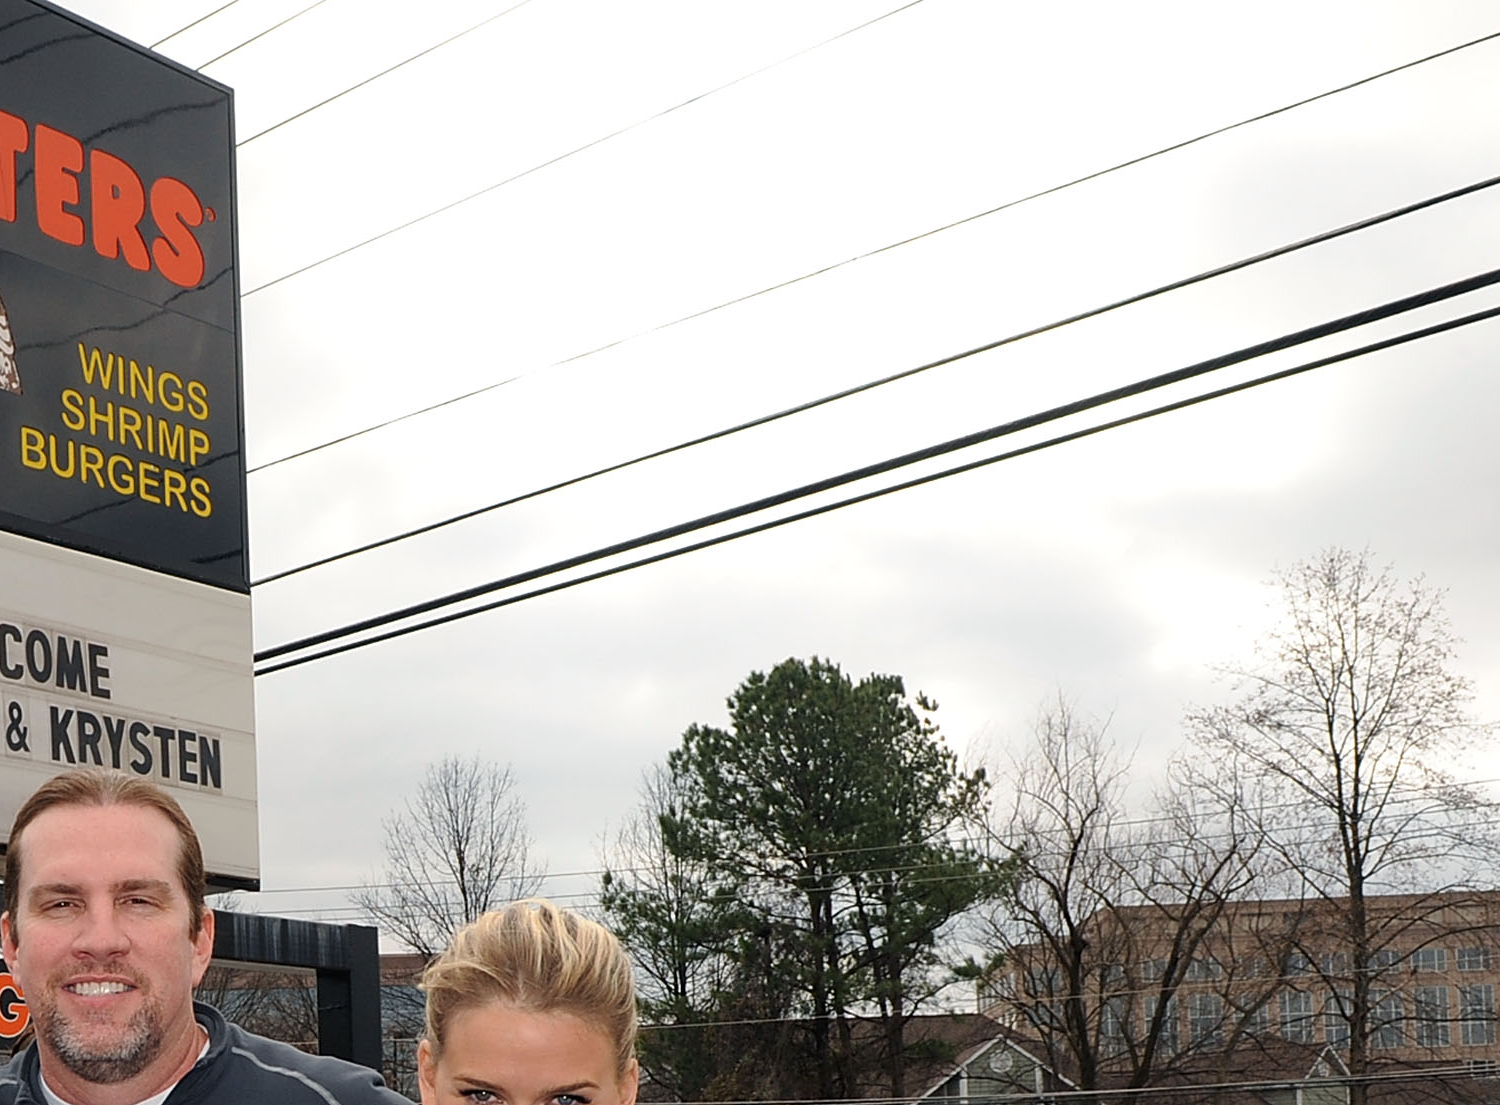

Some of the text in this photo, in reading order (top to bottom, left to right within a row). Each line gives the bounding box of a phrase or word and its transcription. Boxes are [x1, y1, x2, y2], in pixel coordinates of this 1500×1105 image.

[77, 342, 210, 422] WINGS
[60, 388, 211, 468] SHRIMP
[19, 425, 213, 519] BURGERS
[5, 701, 31, 753] &
[49, 705, 223, 790] KRYSTEN
